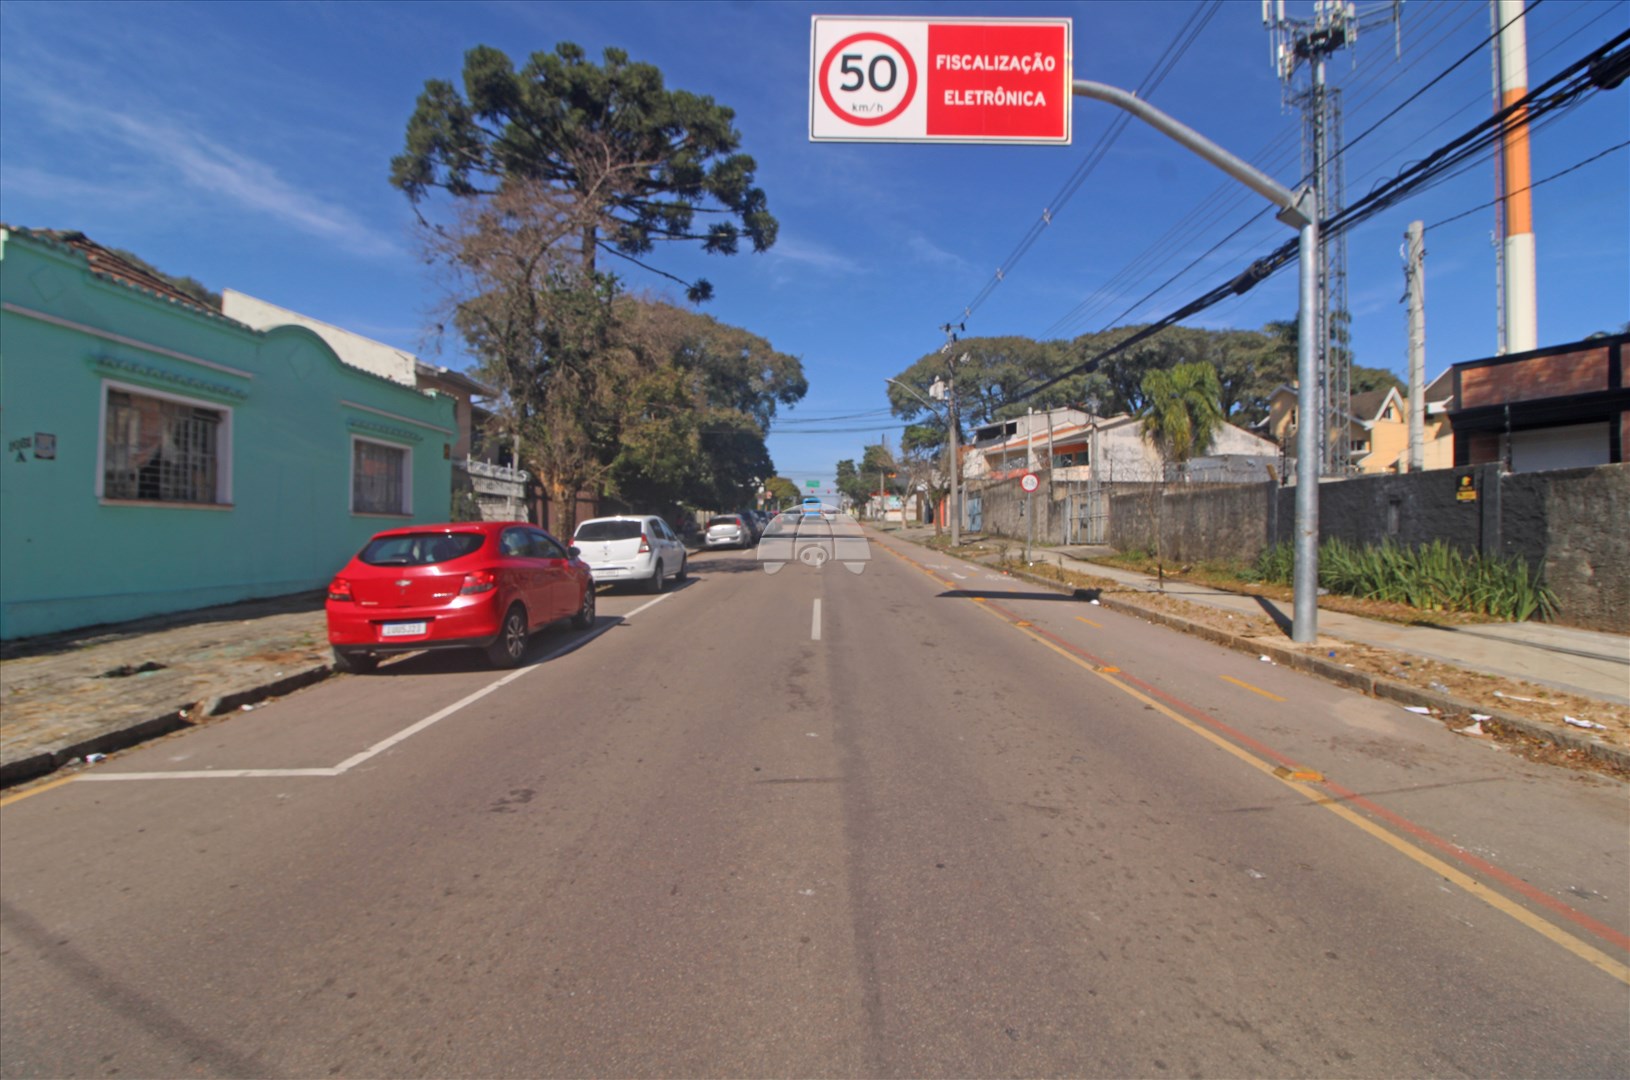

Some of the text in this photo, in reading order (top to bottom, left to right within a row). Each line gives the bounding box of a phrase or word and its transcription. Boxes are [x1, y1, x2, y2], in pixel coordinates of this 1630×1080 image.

[840, 54, 898, 93] 50
[936, 52, 1056, 74] FISCALIZAÇÃO
[944, 86, 1047, 107] ELETRÔNICA
[851, 102, 884, 113] km/h
